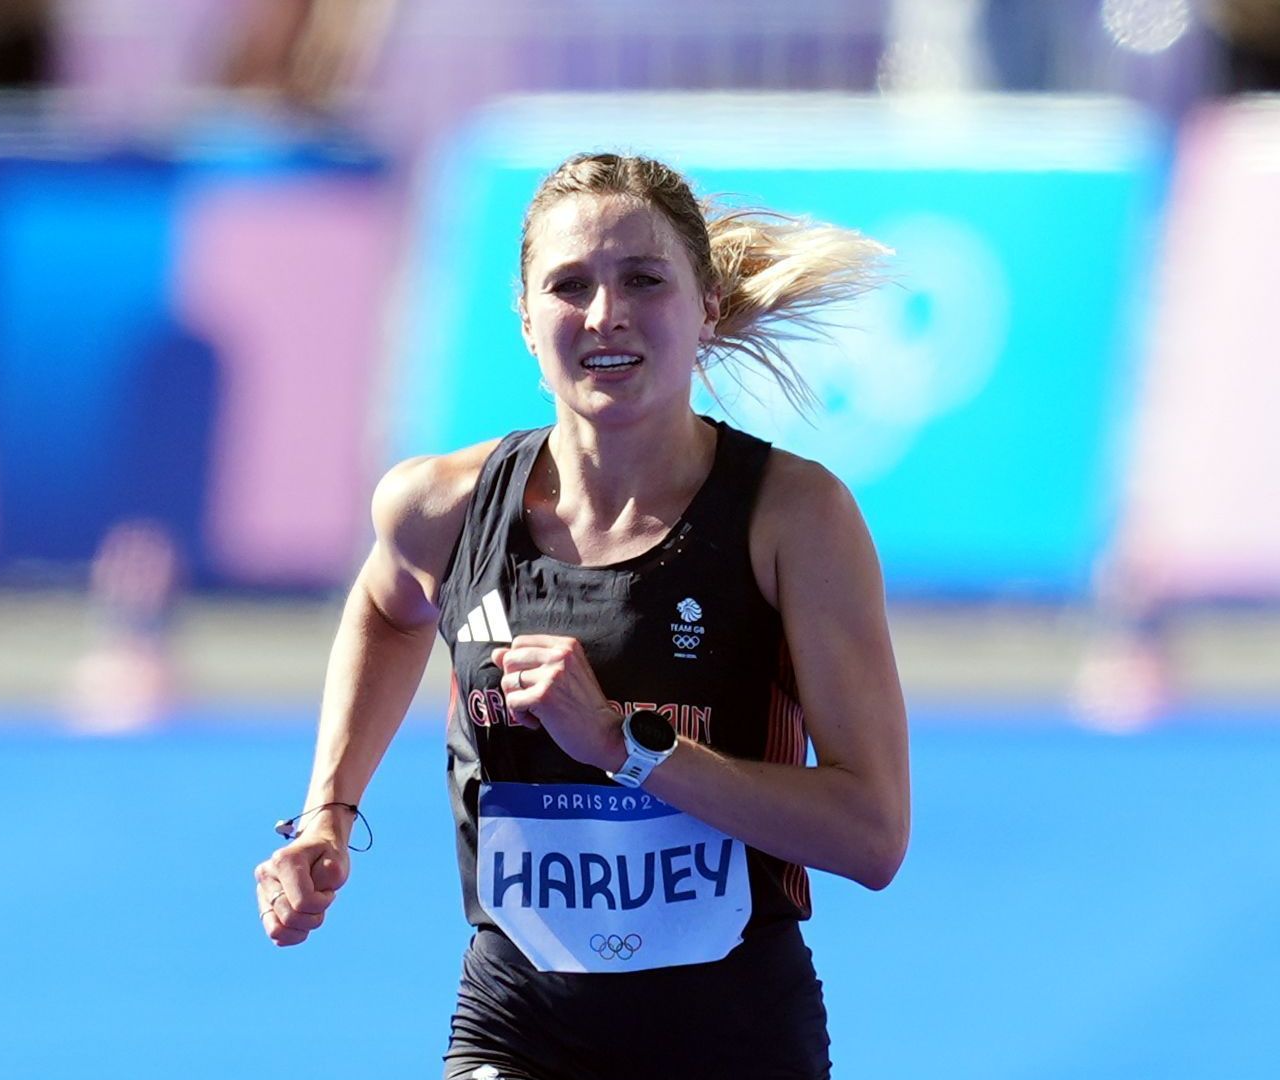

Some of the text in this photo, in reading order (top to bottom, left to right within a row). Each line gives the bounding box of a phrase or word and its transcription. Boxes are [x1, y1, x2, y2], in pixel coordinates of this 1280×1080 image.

[670, 623, 705, 634] TEAM GB
[542, 794, 667, 811] PARIS 202
[493, 838, 733, 911] HARVEY
